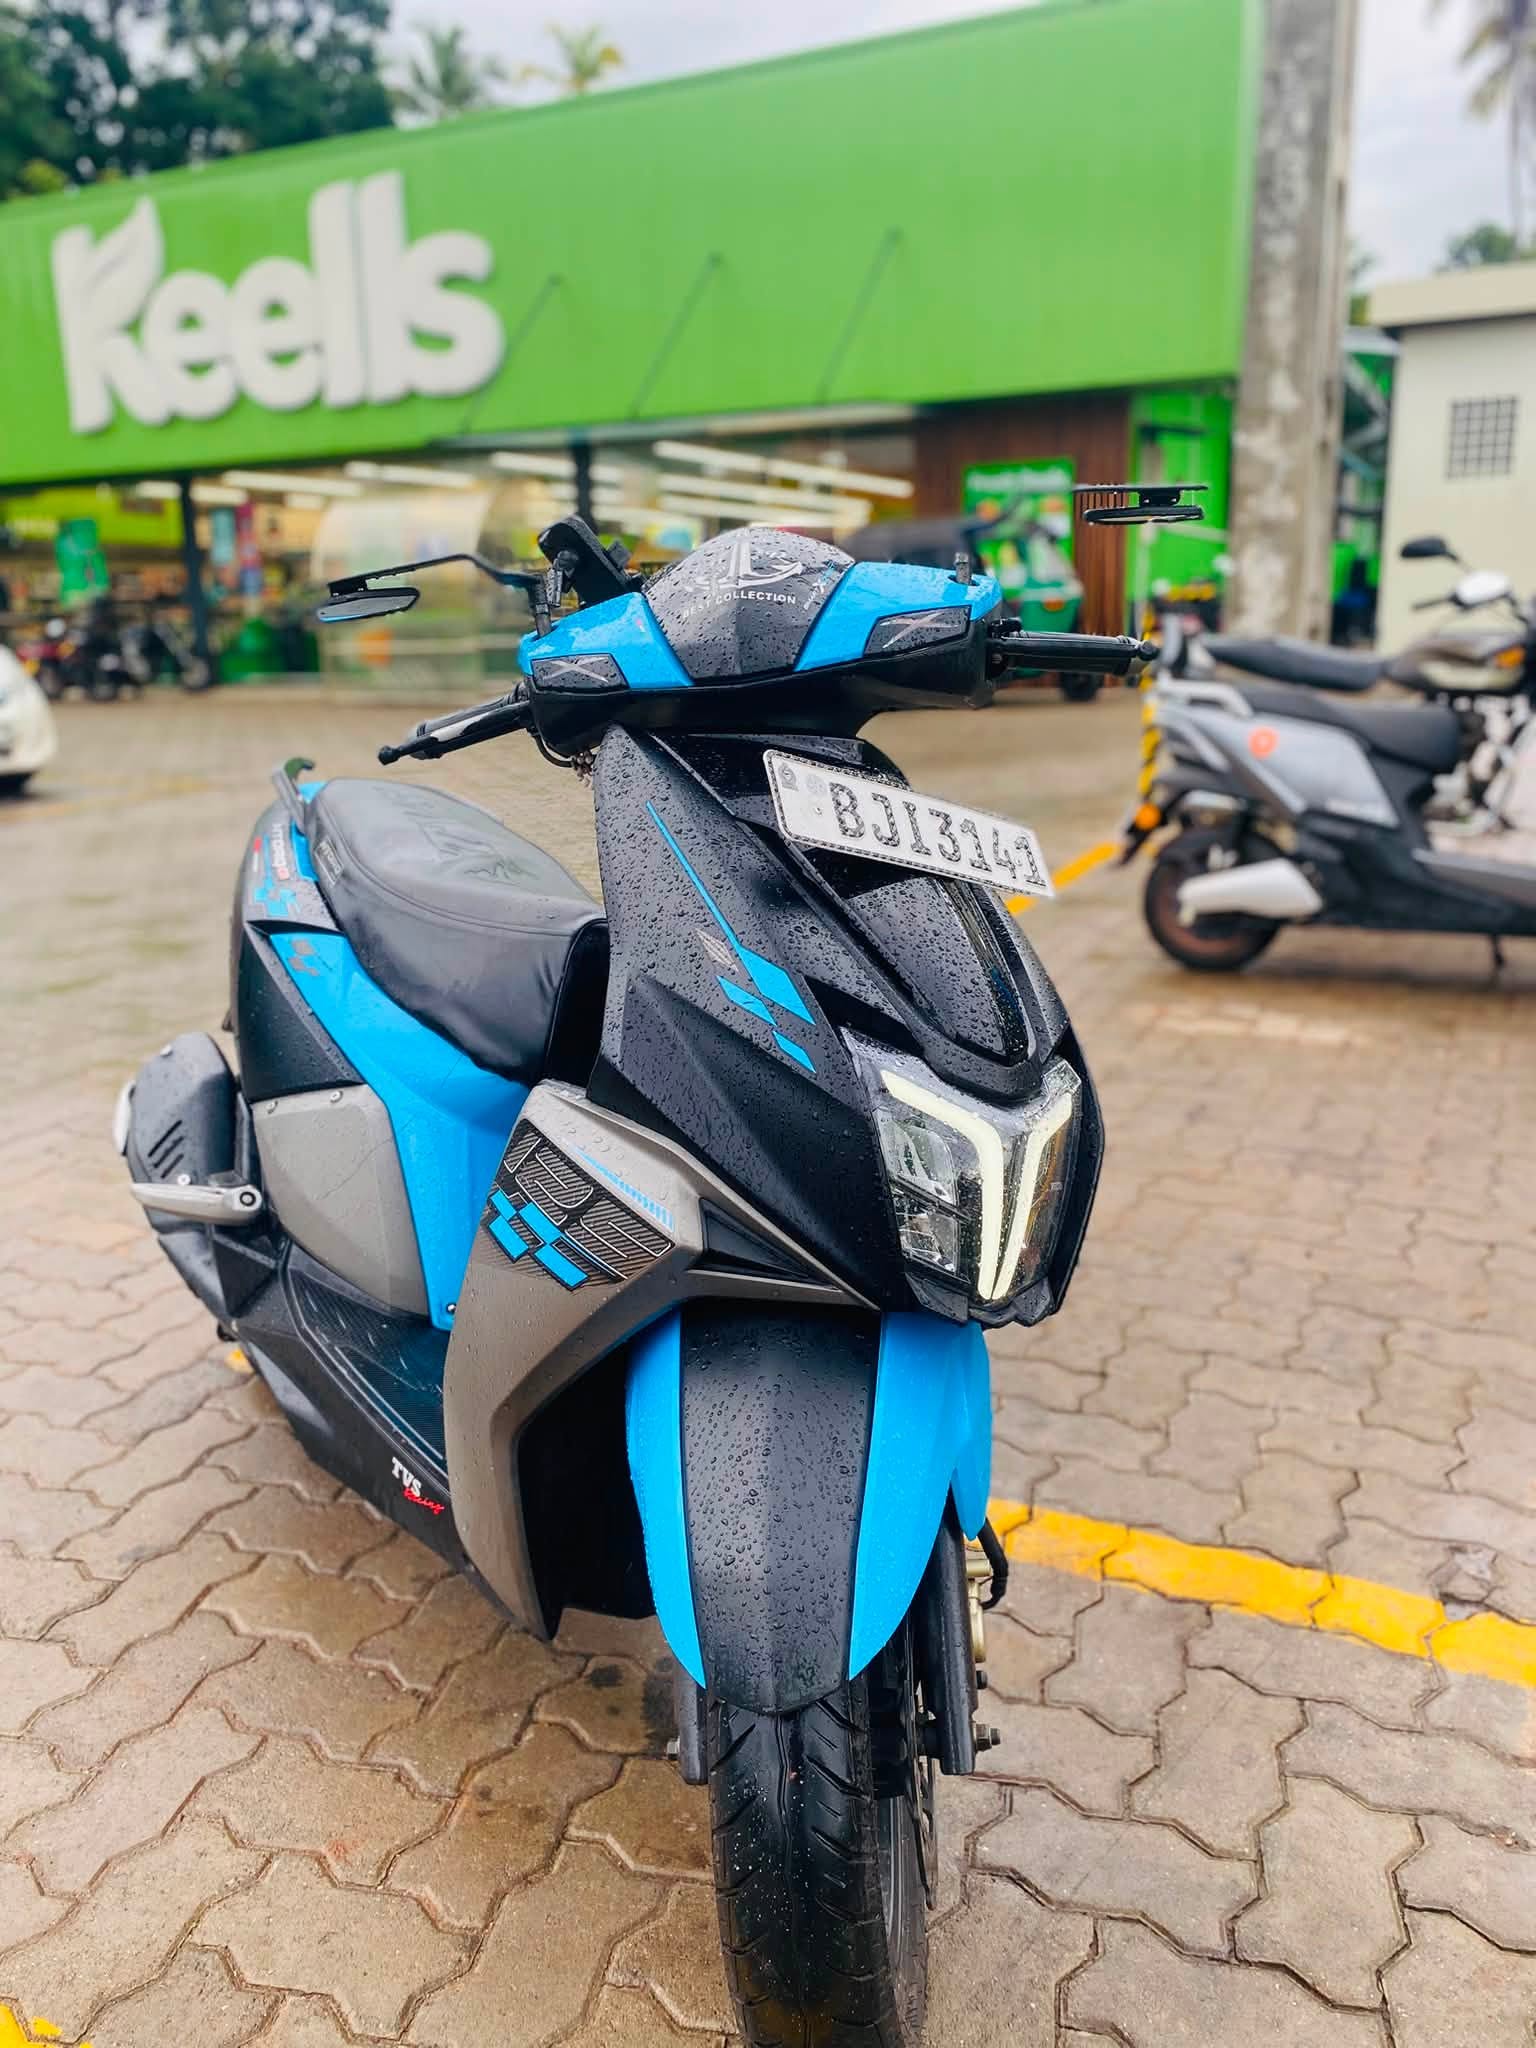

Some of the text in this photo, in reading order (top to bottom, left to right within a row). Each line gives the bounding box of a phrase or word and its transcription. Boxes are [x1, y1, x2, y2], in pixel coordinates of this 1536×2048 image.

[52, 170, 505, 434] Keells
[683, 590, 797, 619] BET COLLECTION
[391, 1456, 422, 1497] TVS
